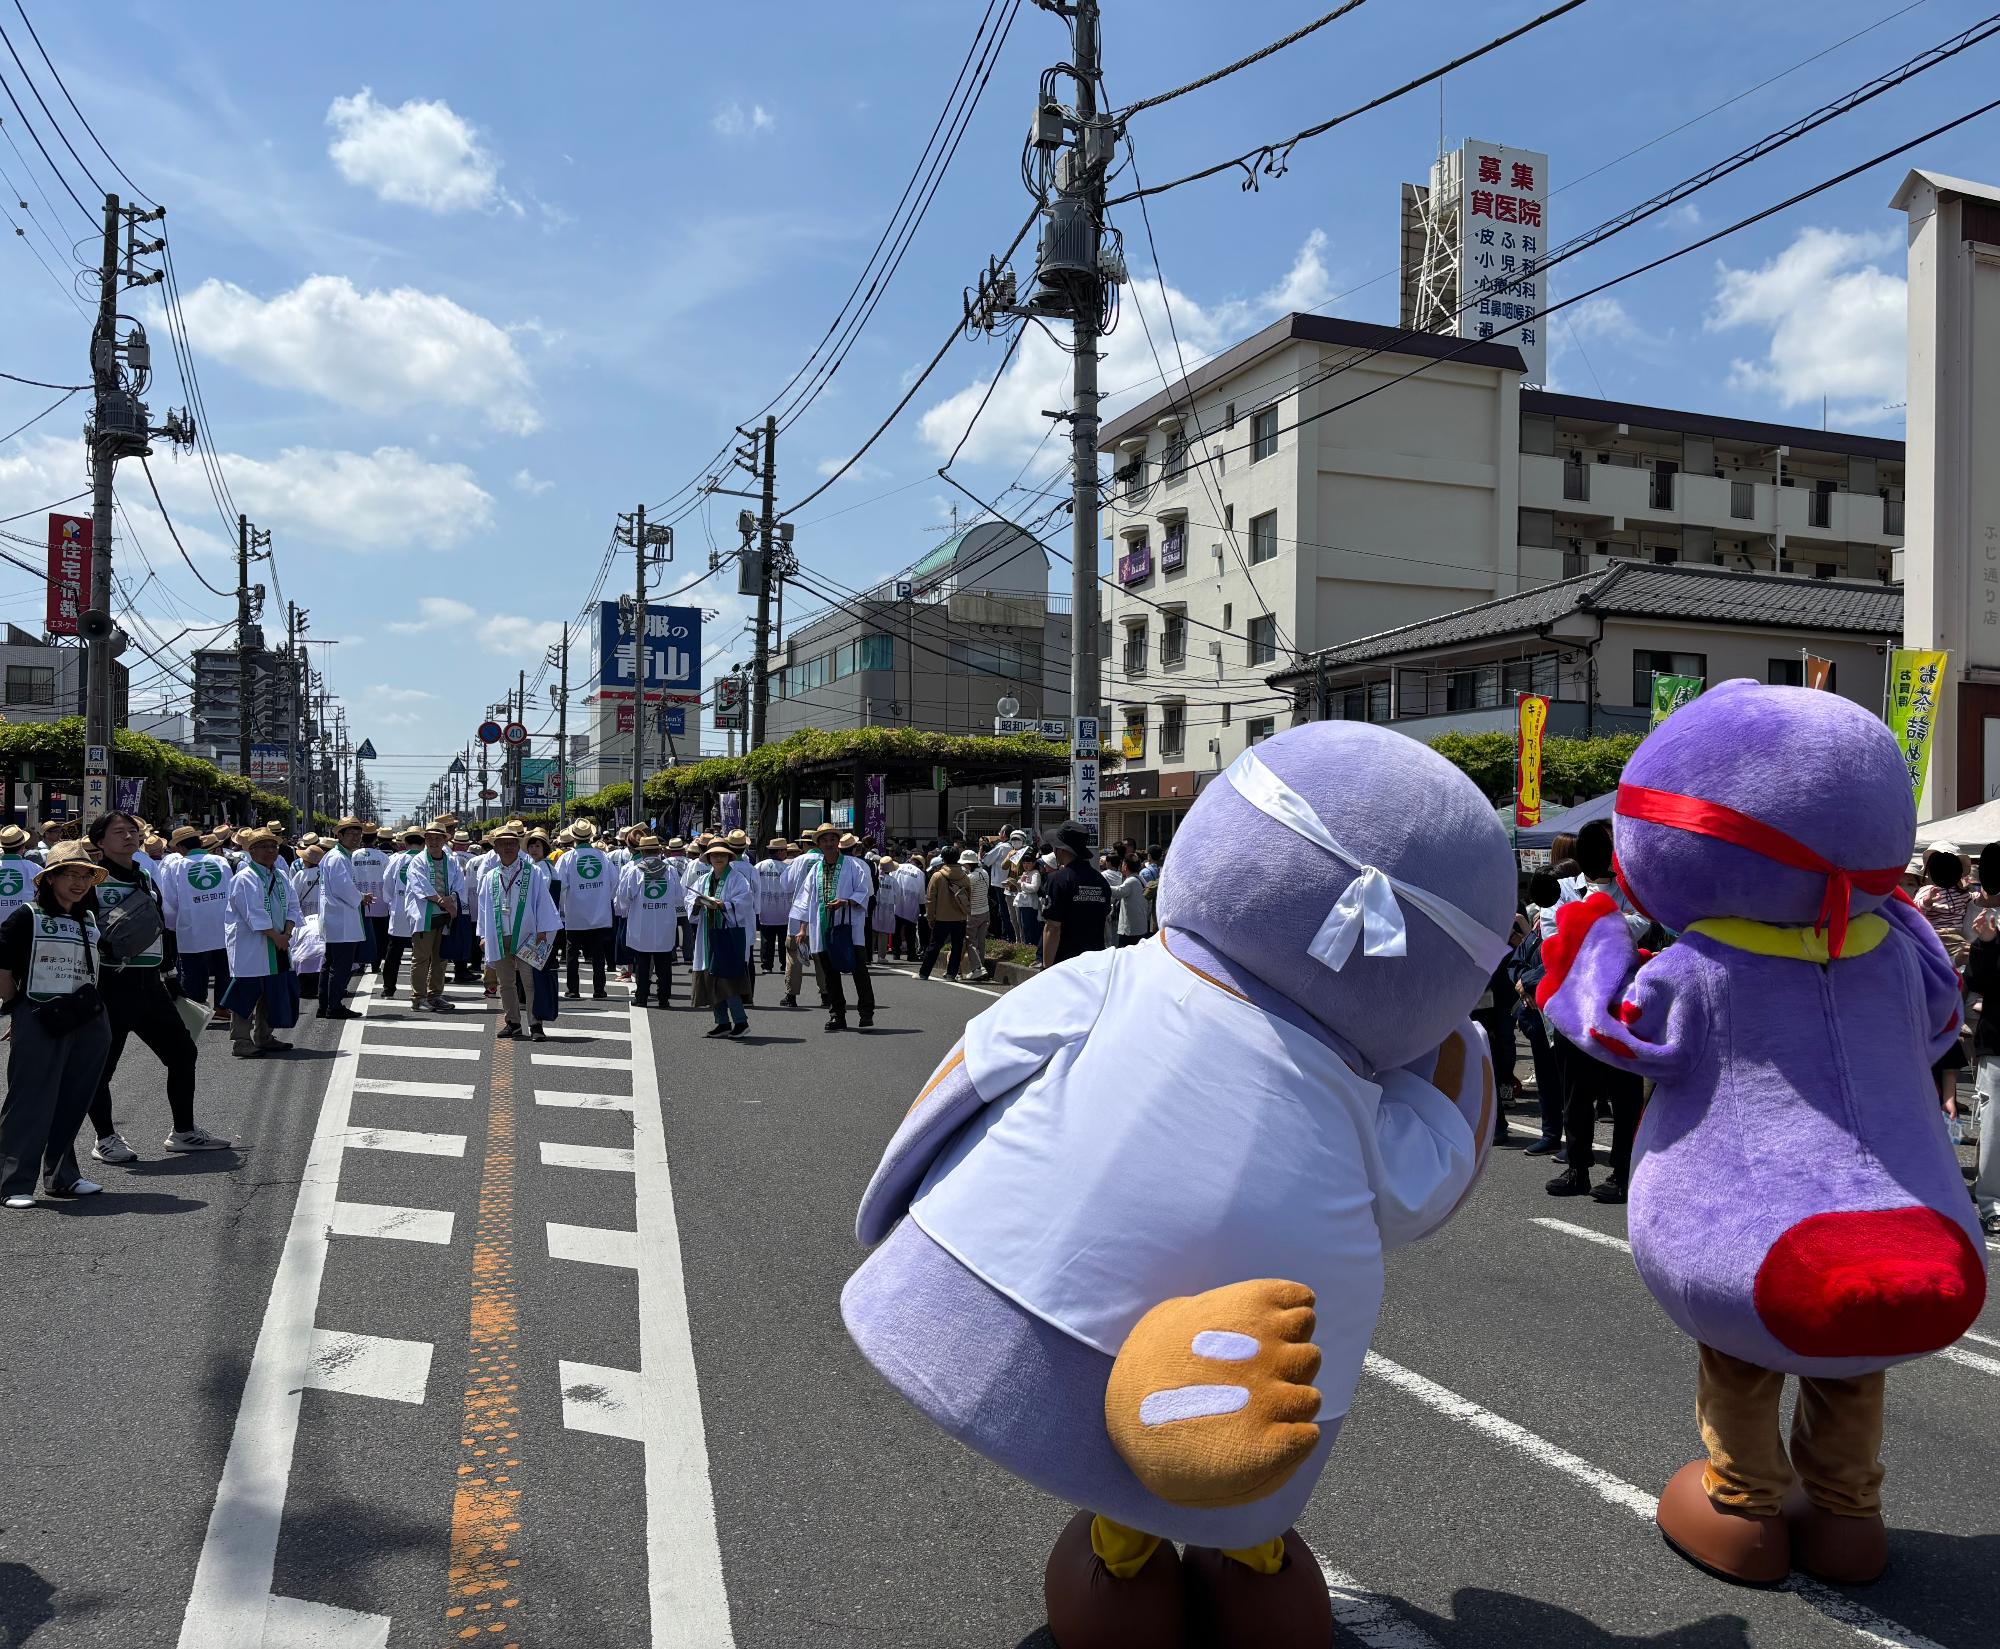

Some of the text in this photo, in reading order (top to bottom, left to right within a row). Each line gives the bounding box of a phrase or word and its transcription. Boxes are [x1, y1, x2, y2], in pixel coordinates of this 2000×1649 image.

[1478, 155, 1534, 191] 募集
[1470, 189, 1541, 228] 貸医院
[1479, 229, 1536, 254] 皮ふ科
[1479, 252, 1536, 277] 小児科
[1479, 274, 1536, 300] 心療内科
[1479, 298, 1536, 323] 耳鼻咽喉科
[60, 540, 81, 619] 住宅情報
[1983, 526, 1999, 625] ふじ通り店
[50, 620, 78, 631] エヌ・ケー
[613, 641, 690, 681] 青山
[509, 728, 522, 739] 40
[1001, 720, 1063, 735] 昭和ビル第5
[1082, 721, 1095, 738] 質
[90, 748, 103, 761] 質
[1527, 704, 1536, 801] キーマカレー
[89, 779, 102, 808] 並木
[1081, 763, 1096, 804] 並木
[578, 881, 604, 891] 春日部市
